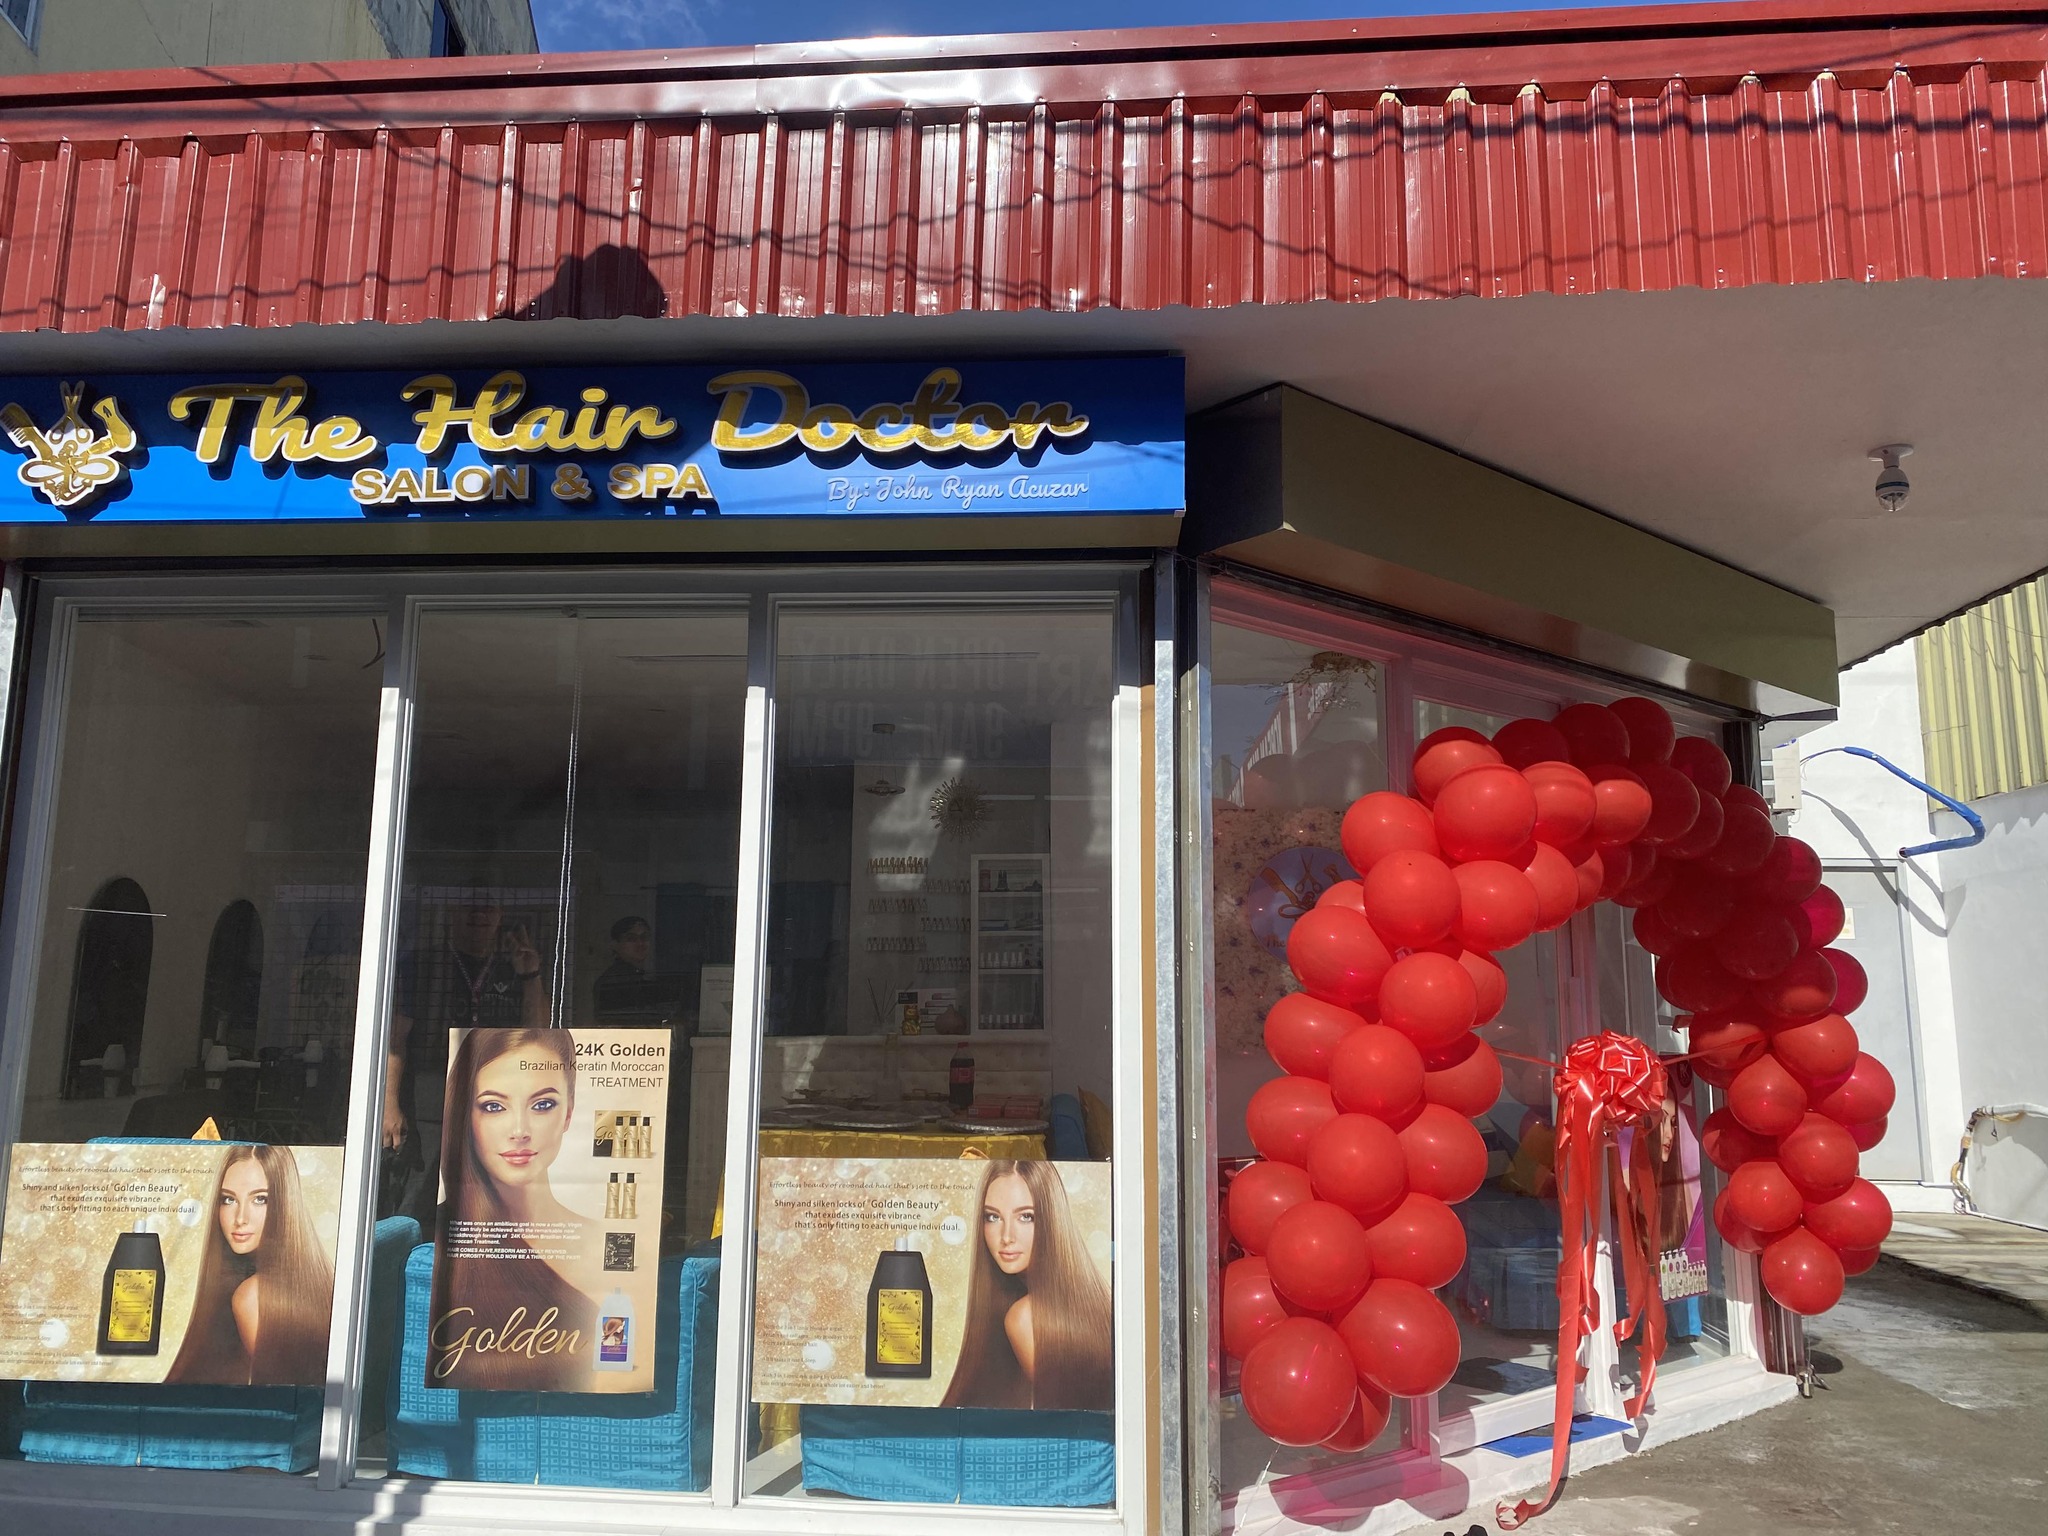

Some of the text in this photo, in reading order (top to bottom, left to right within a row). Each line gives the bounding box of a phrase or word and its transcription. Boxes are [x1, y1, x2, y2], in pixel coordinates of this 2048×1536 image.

[168, 366, 1090, 463] The Hair Doctor
[350, 463, 713, 505] SALON & SPA
[828, 477, 870, 511] By:
[874, 475, 933, 501] John
[940, 475, 1004, 510] Ryan
[575, 1042, 666, 1057] 24K Golden
[519, 1060, 665, 1072] Brazilian Keratin Moroccan
[590, 1077, 664, 1088] TREATMENT
[22, 1183, 43, 1192] Shiny
[82, 1184, 100, 1192] locks
[101, 1184, 110, 1192] of
[40, 1204, 60, 1212] that's
[61, 1204, 78, 1213] only
[79, 1205, 102, 1213] fitting
[774, 1199, 796, 1208] Shiny
[837, 1200, 856, 1208] locks
[805, 1211, 921, 1220] that exudes exquisite vibrance
[817, 1221, 835, 1230] only
[836, 1222, 860, 1230] fitting
[890, 1223, 918, 1231] unique
[431, 1306, 589, 1380] Golden
